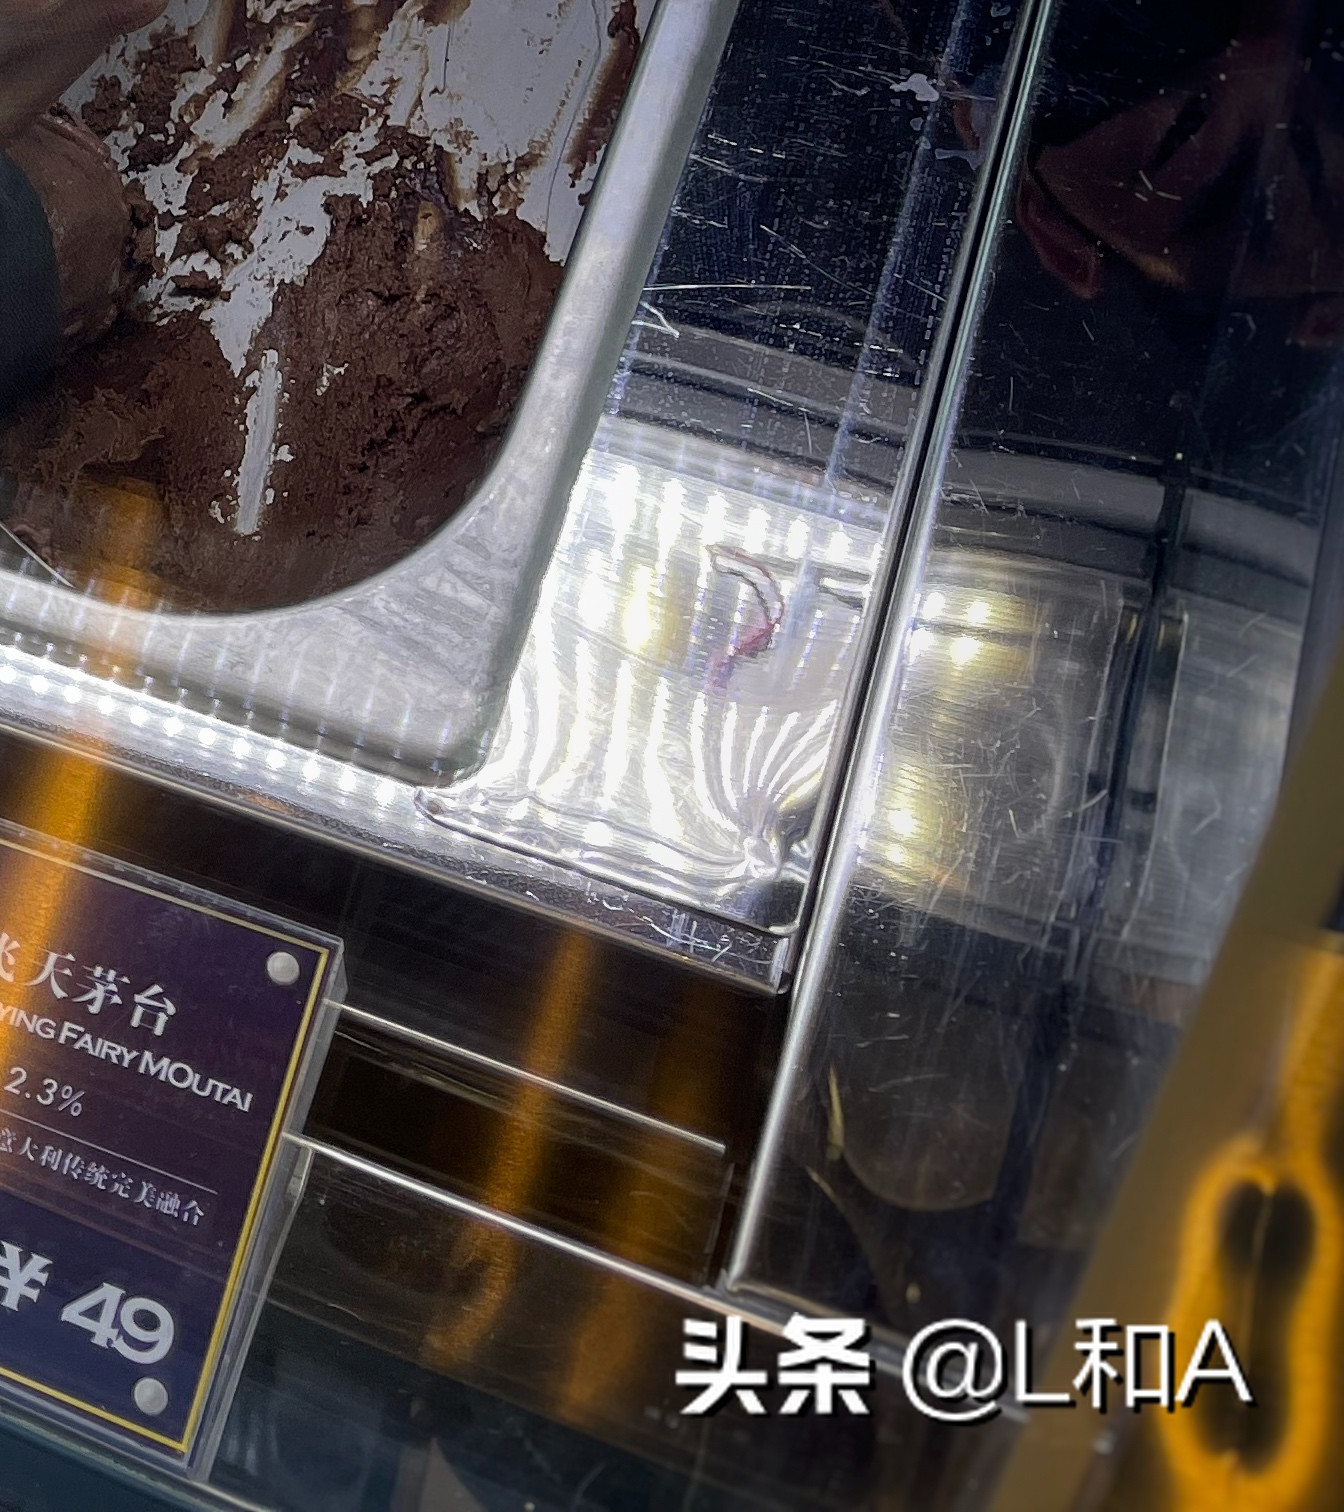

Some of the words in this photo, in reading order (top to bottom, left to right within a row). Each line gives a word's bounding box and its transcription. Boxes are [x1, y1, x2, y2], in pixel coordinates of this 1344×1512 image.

[3, 1066, 85, 1117] 2.3%
[57, 1021, 140, 1069] FAIRY
[138, 1050, 254, 1113] MOUTAI
[61, 1282, 175, 1365] 49
